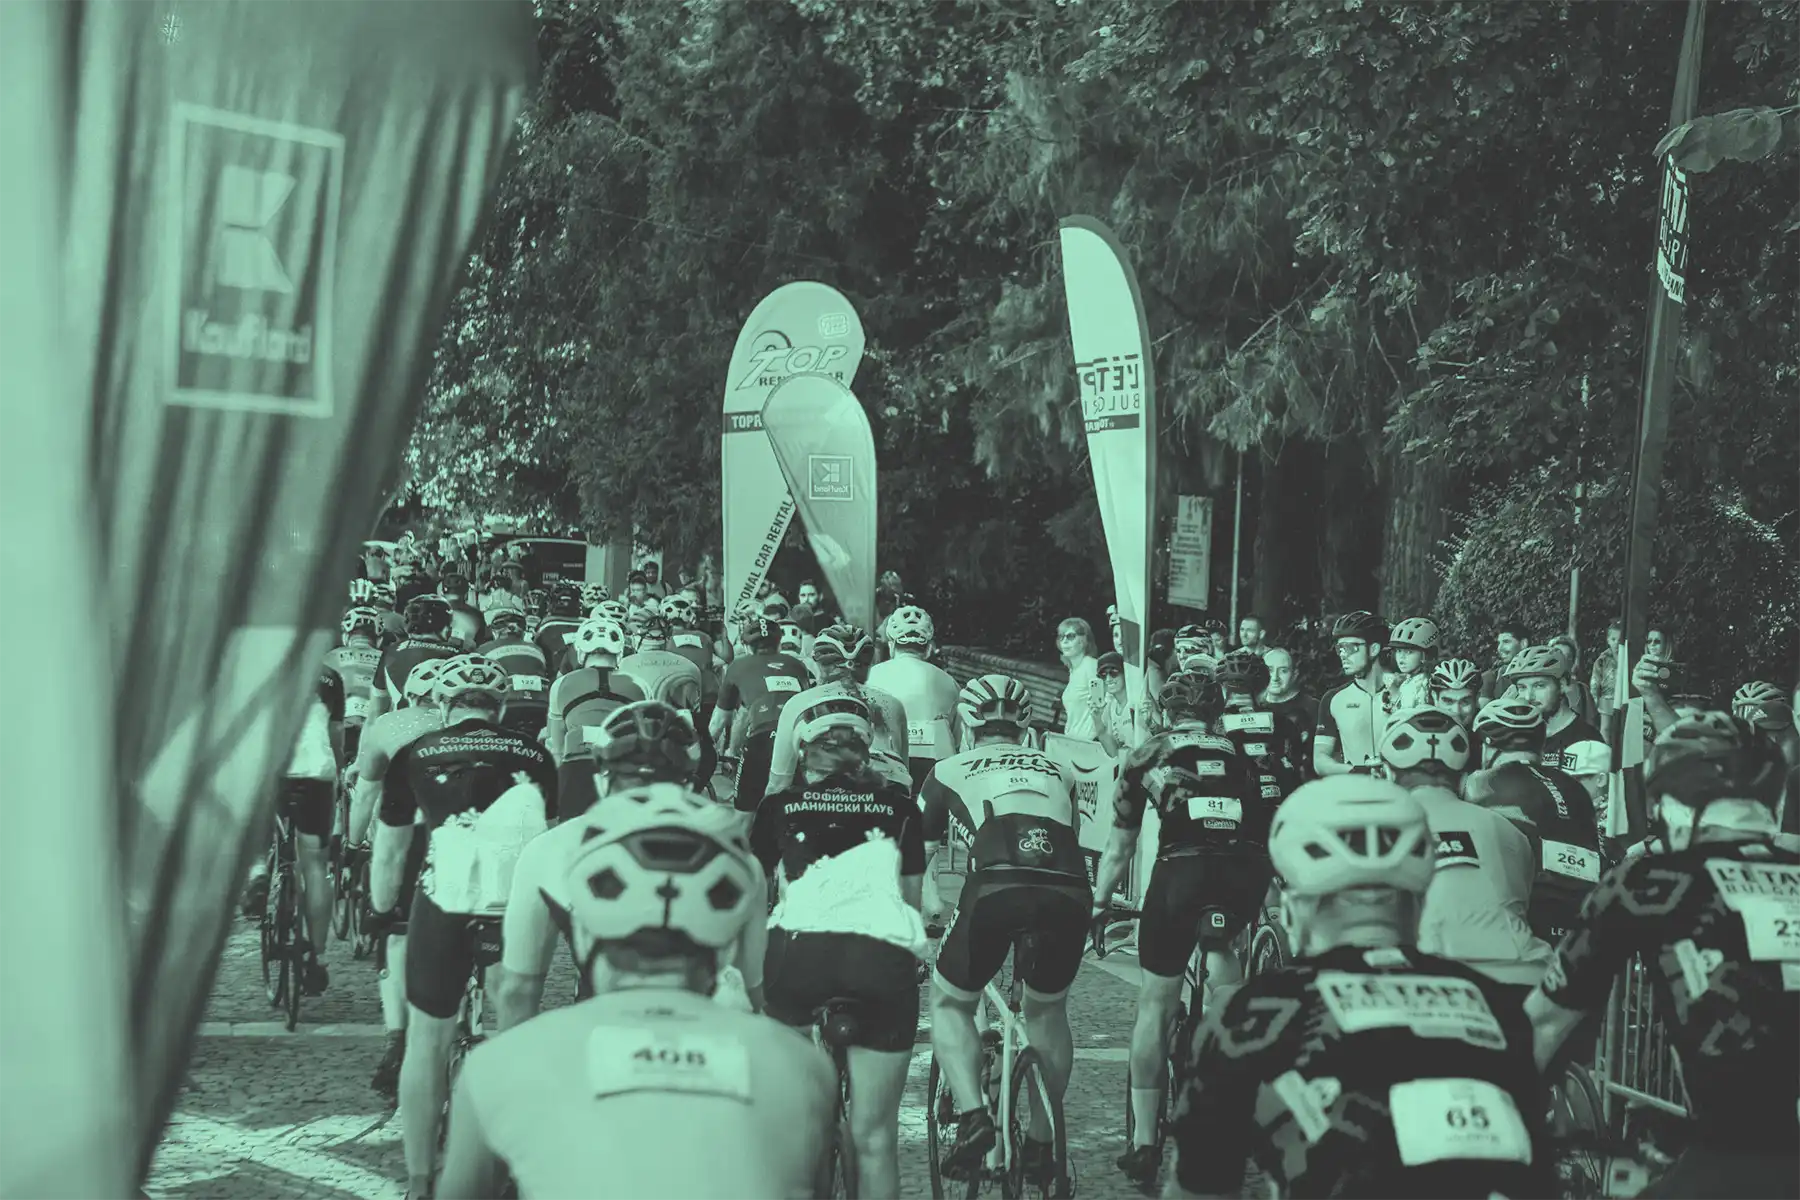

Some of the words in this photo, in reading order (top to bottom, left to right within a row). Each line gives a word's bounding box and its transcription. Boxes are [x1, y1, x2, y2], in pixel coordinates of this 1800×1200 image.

[735, 344, 848, 391] TOP
[731, 414, 763, 429] TOPR
[755, 543, 772, 568] CAR
[766, 500, 793, 543] RENTAL
[440, 736, 524, 746] СОФИЙСКИ
[417, 743, 509, 758] ПЛАНИНСКИ
[512, 746, 544, 762] КЛУБ
[803, 791, 875, 802] СОФИЙСКИ
[784, 801, 860, 814] ПЛАНИНСКИ
[863, 803, 894, 815] КЛУБ
[1207, 800, 1224, 810] 81
[1556, 852, 1586, 868] 264
[1446, 1106, 1490, 1128] 65
